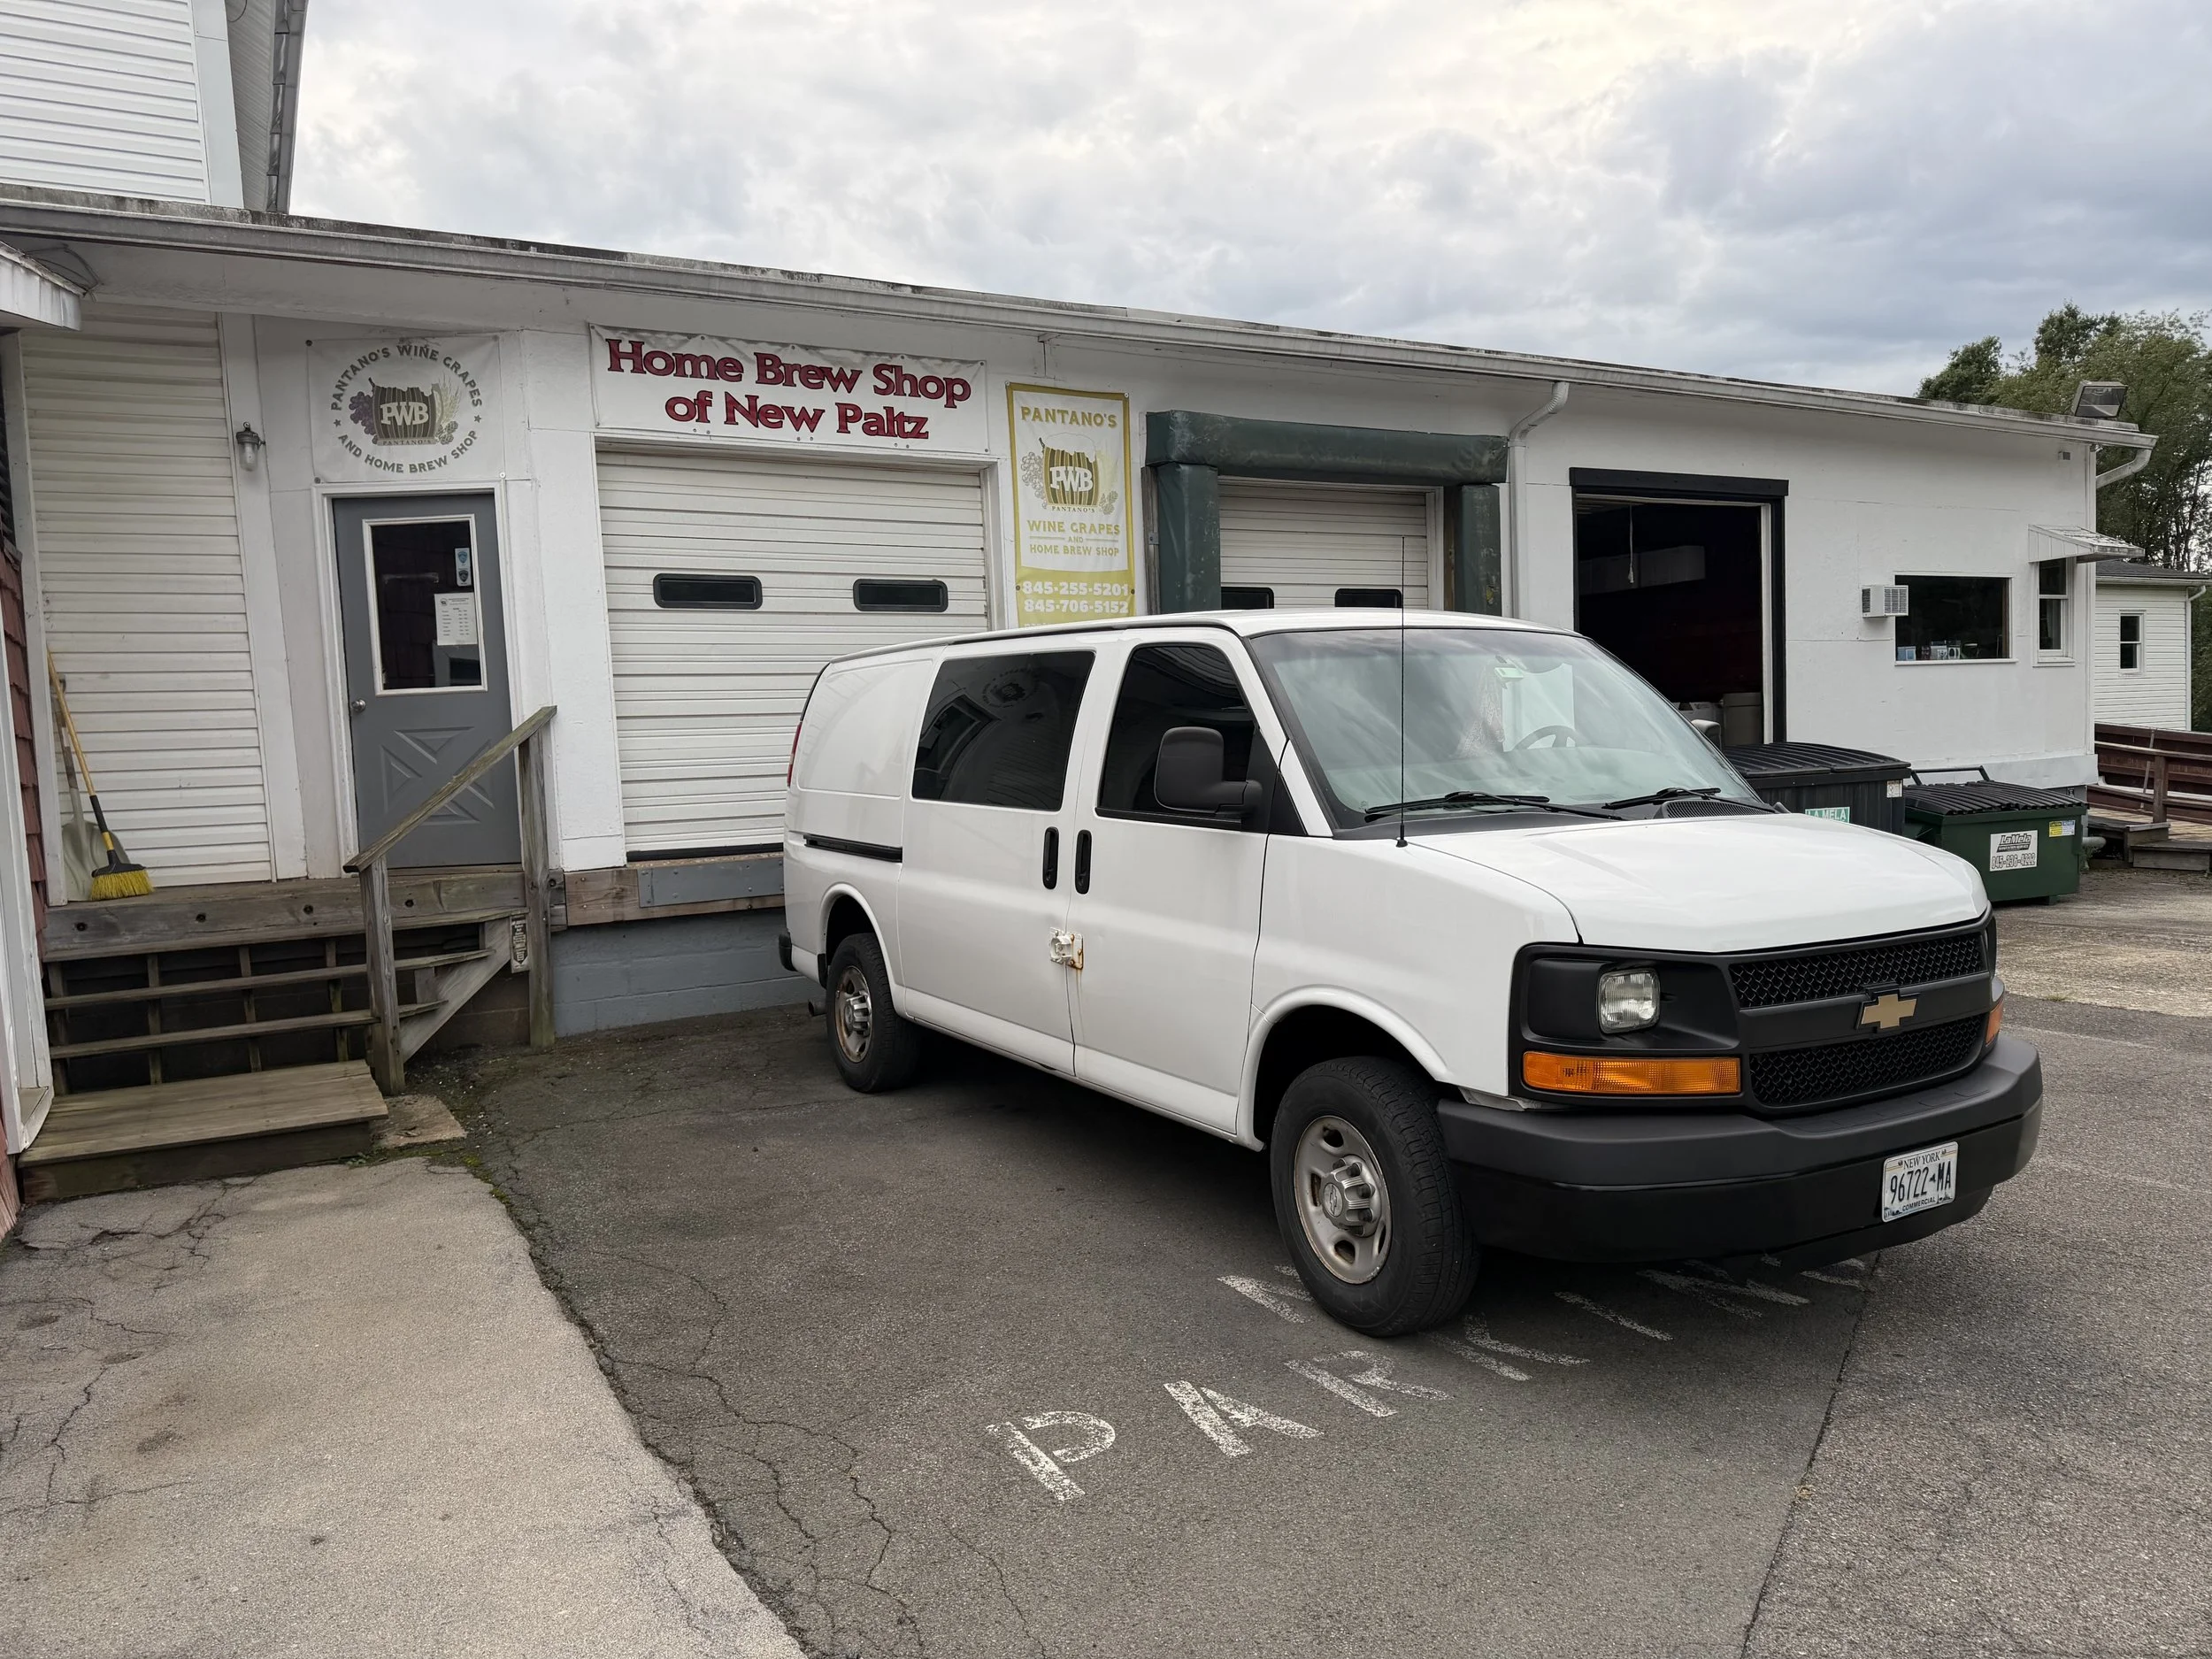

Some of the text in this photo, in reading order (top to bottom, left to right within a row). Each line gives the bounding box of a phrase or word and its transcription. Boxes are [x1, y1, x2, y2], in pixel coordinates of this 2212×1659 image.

[331, 344, 483, 411] PANTANO'S WINE GRAPES
[605, 337, 972, 409] Home Brew Shop
[380, 401, 430, 426] PWB
[664, 390, 930, 440] of New Paltz
[1021, 406, 1118, 428] PANTANO'S
[338, 430, 479, 473] AND HOME BREW SHOP
[1049, 465, 1094, 493] PWB
[1051, 505, 1095, 514] PANTANO'S
[1027, 520, 1120, 535] WINE GRAPES
[1029, 544, 1119, 557] HOME BREW SHOP
[2000, 833, 2032, 845] LaMela
[1903, 1150, 1941, 1170] NEW YORK
[1890, 1167, 1929, 1204] 96722
[1902, 1196, 1936, 1211] COMMERCIAL
